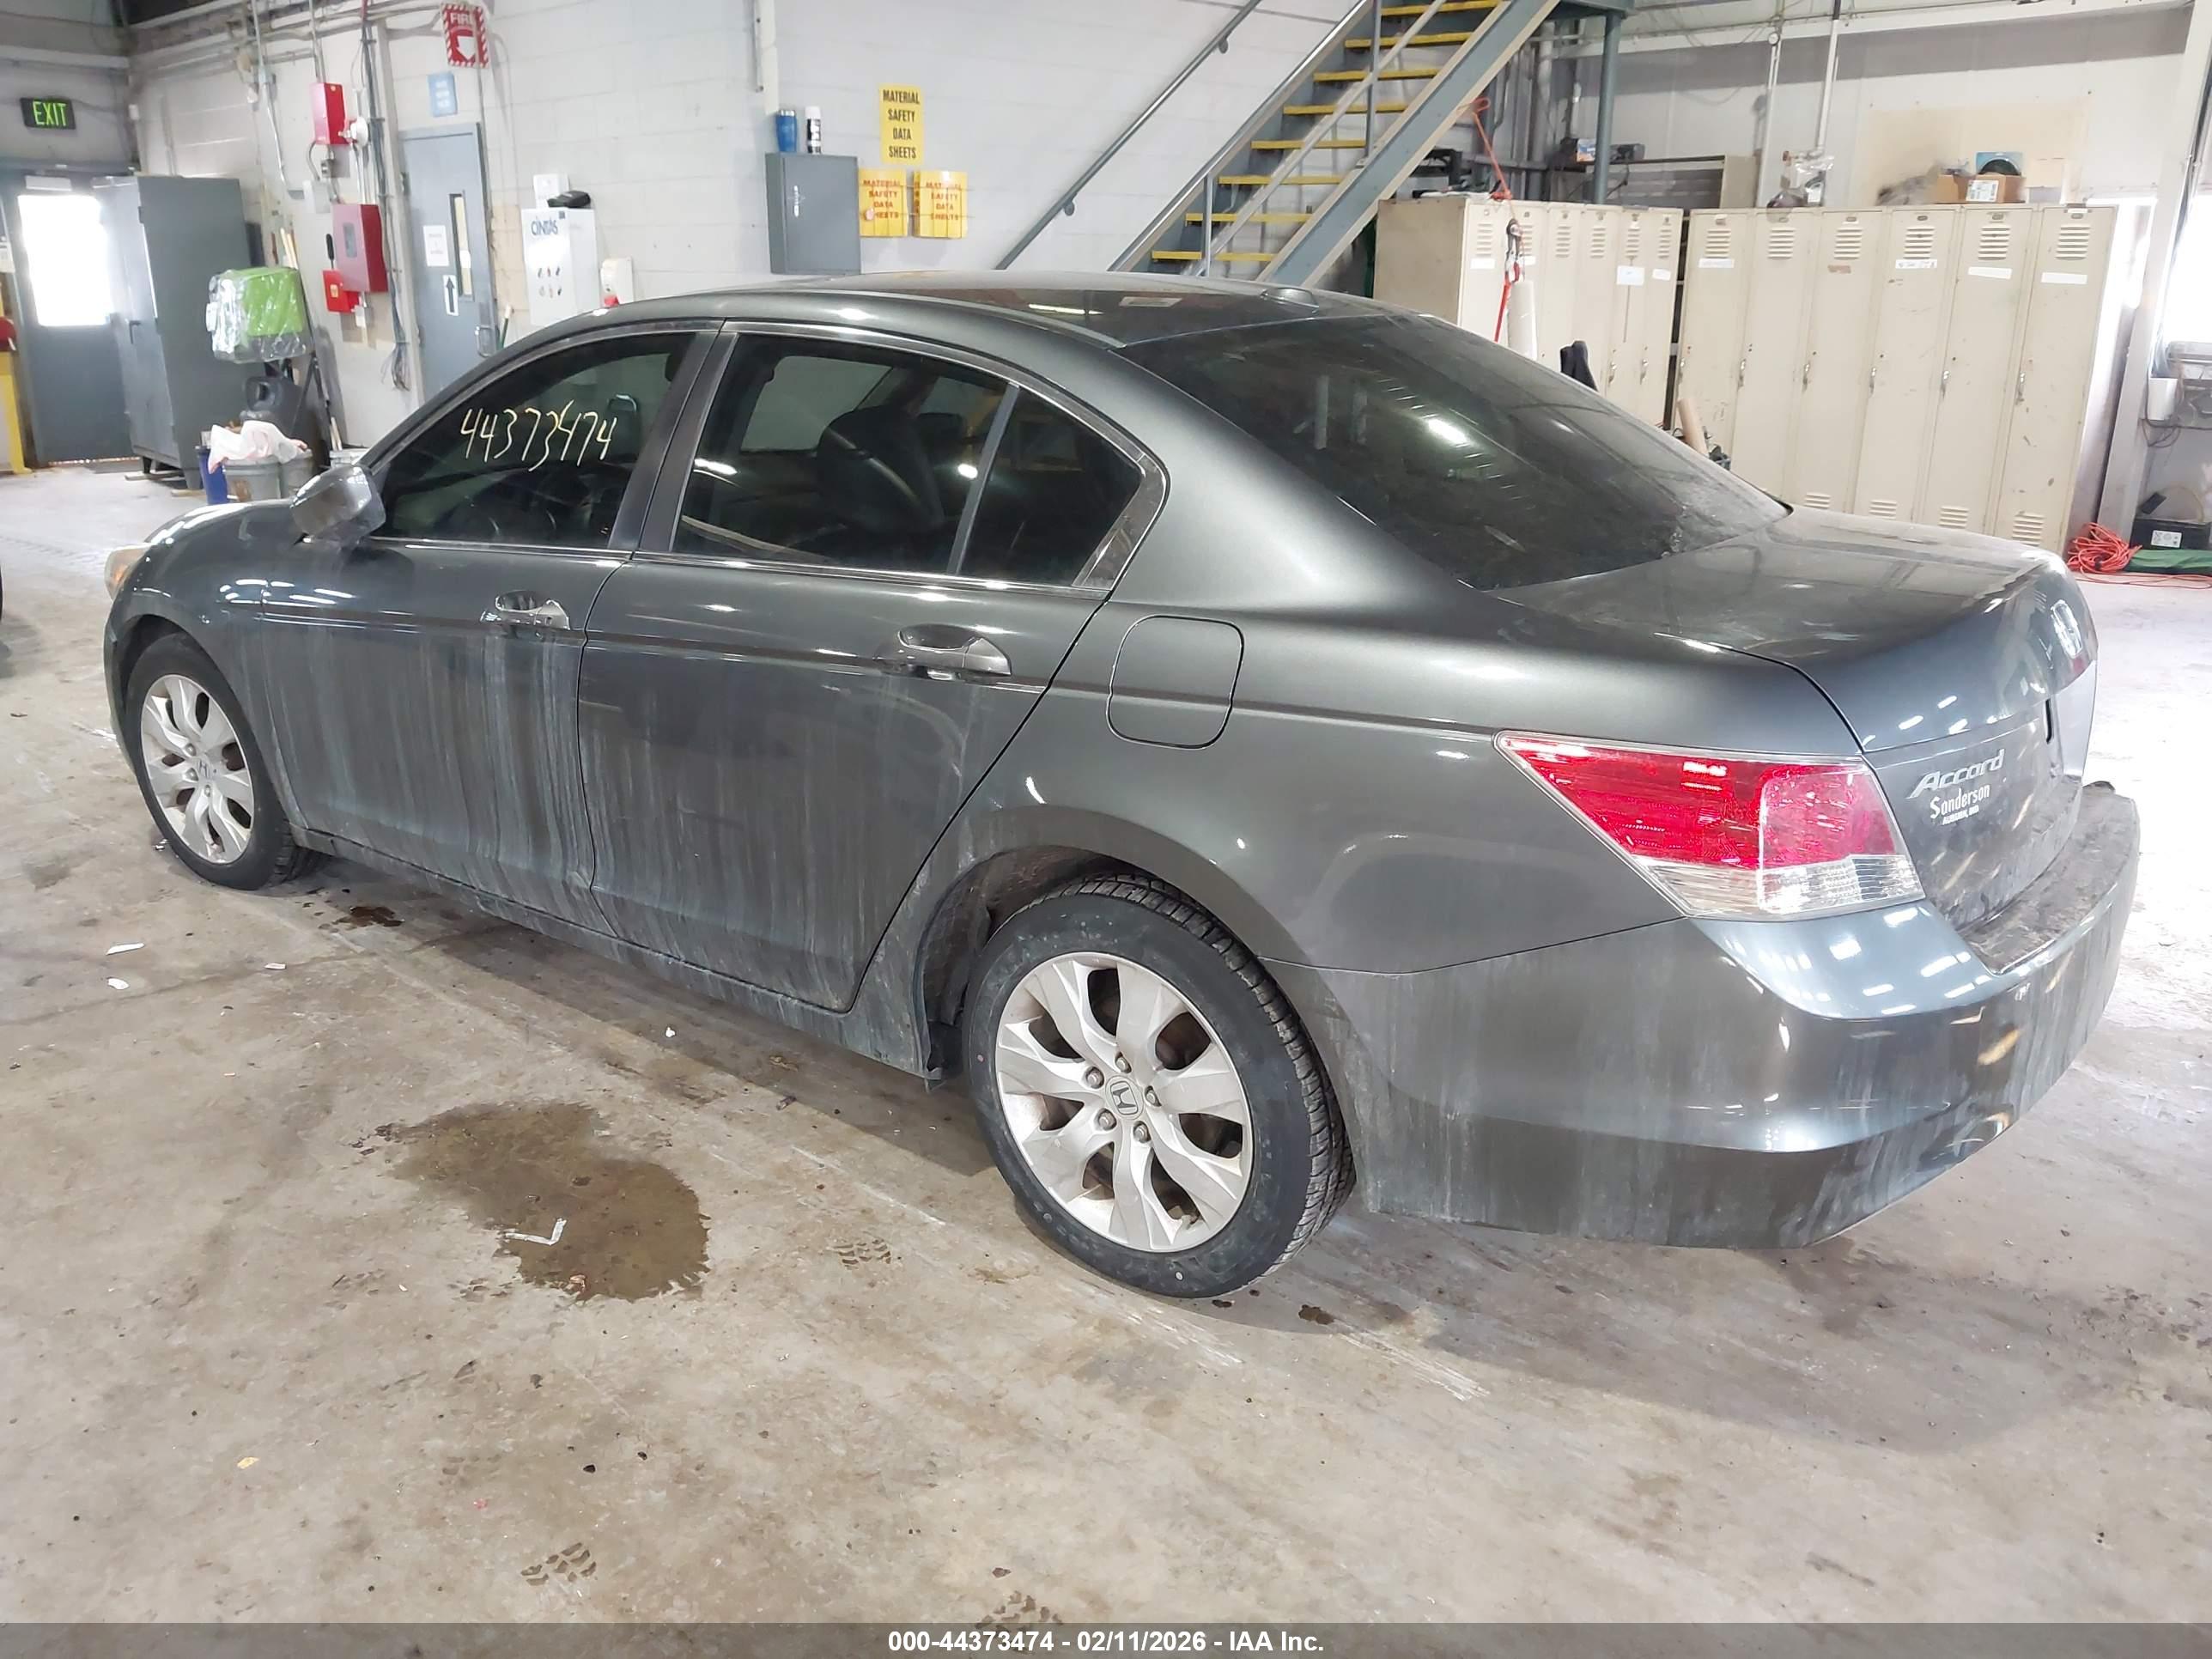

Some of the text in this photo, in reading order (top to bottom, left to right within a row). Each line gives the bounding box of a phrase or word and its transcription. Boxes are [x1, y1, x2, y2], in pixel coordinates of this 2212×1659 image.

[882, 88, 921, 105] MATERIAL
[33, 100, 67, 126] EXIT
[887, 108, 915, 122] SAFETY
[892, 127, 912, 140] DATA
[888, 145, 917, 159] SHEETS
[862, 179, 901, 188] MATERIAL
[926, 181, 963, 191] MATAL
[868, 190, 898, 198] SAFETY
[873, 201, 894, 210] DATA
[935, 203, 954, 211] DATA
[863, 211, 900, 221] HEETS
[460, 399, 617, 472] 44373474
[1904, 748, 2005, 799] Accord
[1929, 784, 1990, 819] Sanderson
